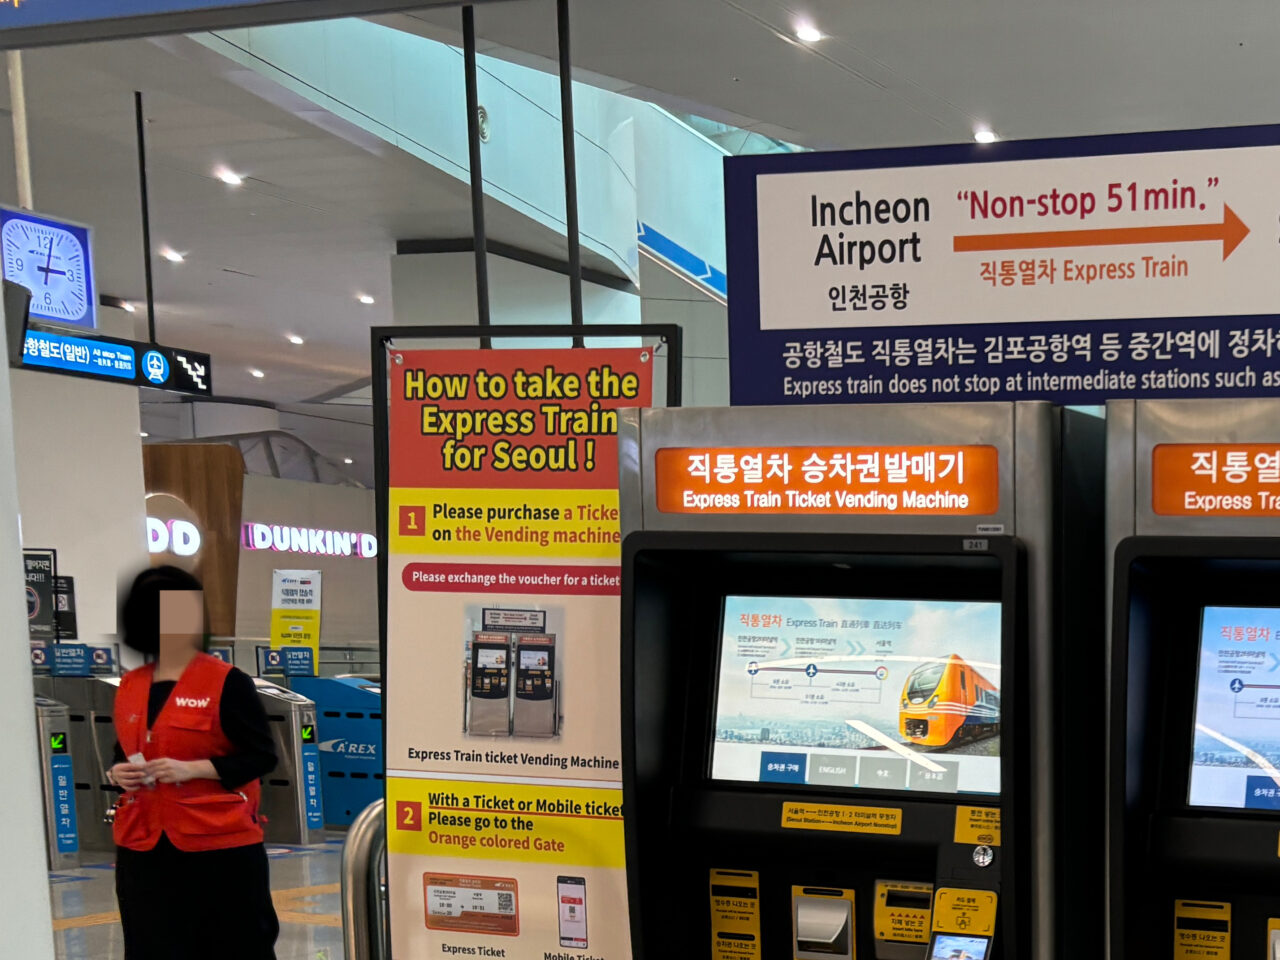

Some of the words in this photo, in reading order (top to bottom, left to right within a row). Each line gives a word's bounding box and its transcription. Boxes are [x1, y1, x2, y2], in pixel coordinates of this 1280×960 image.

[810, 190, 930, 227] Incheon
[813, 232, 922, 271] Airport
[980, 258, 1057, 287] 직통열차
[1063, 258, 1136, 285] Express
[1142, 254, 1189, 280] Train
[828, 282, 911, 312] 인천공항
[782, 340, 866, 369] 공항철도
[871, 337, 978, 367] 직통열차는
[983, 333, 1093, 364] 김포공항역
[1099, 332, 1122, 362] 등
[1128, 329, 1221, 361] 중간역에
[404, 370, 469, 400] How
[474, 370, 507, 400] to
[513, 365, 580, 399] take
[586, 365, 639, 399] the
[783, 376, 842, 398] Express
[847, 374, 883, 395] train
[888, 373, 928, 394] does
[932, 375, 961, 393] not
[964, 373, 1001, 397] stop
[1005, 373, 1023, 391] at
[1027, 369, 1136, 392] intermediate
[1141, 367, 1210, 390] stations
[1215, 366, 1255, 388] such
[421, 404, 535, 440] Express
[540, 402, 618, 434] Train
[442, 440, 487, 471] for
[492, 439, 577, 471] Seoul
[687, 452, 793, 484] 직통열차
[683, 490, 741, 510] Express
[744, 490, 782, 508] Train
[787, 490, 832, 508] Ticket
[835, 490, 898, 511] Vending
[903, 490, 969, 509] Machine
[1184, 491, 1252, 512] Express
[407, 512, 418, 529] 1
[432, 503, 483, 520] Please
[487, 504, 560, 523] purchase
[564, 508, 573, 520] a
[253, 523, 357, 557] DUNKIN'
[432, 529, 452, 541] on
[456, 527, 481, 542] the
[485, 526, 550, 547] Vending
[553, 527, 621, 544] machine
[412, 570, 446, 583] Please
[448, 572, 497, 587] exchange
[499, 573, 516, 585] the
[518, 573, 561, 586] voucher
[564, 573, 580, 586] for
[581, 577, 589, 586] a
[590, 574, 621, 587] ticket
[740, 613, 783, 628] 직통열차
[786, 617, 817, 629] Express
[818, 618, 838, 628] Train
[1220, 625, 1271, 642] 직통열차
[408, 748, 451, 763] Express
[454, 749, 482, 763] Train
[485, 751, 518, 765] ticket
[520, 752, 568, 770] Vending
[571, 755, 620, 770] Machine
[428, 792, 460, 808] With
[462, 797, 470, 808] a
[473, 795, 515, 811] Ticket
[518, 800, 533, 812] or
[536, 799, 582, 815] Mobile
[403, 807, 415, 826] 2
[428, 813, 471, 828] Please
[474, 818, 491, 831] go
[494, 817, 508, 830] to
[510, 815, 534, 831] the
[428, 830, 477, 849] Orange
[480, 834, 530, 851] colored
[533, 837, 565, 853] Gate
[441, 943, 476, 957] Express
[477, 946, 505, 959] Ticket
